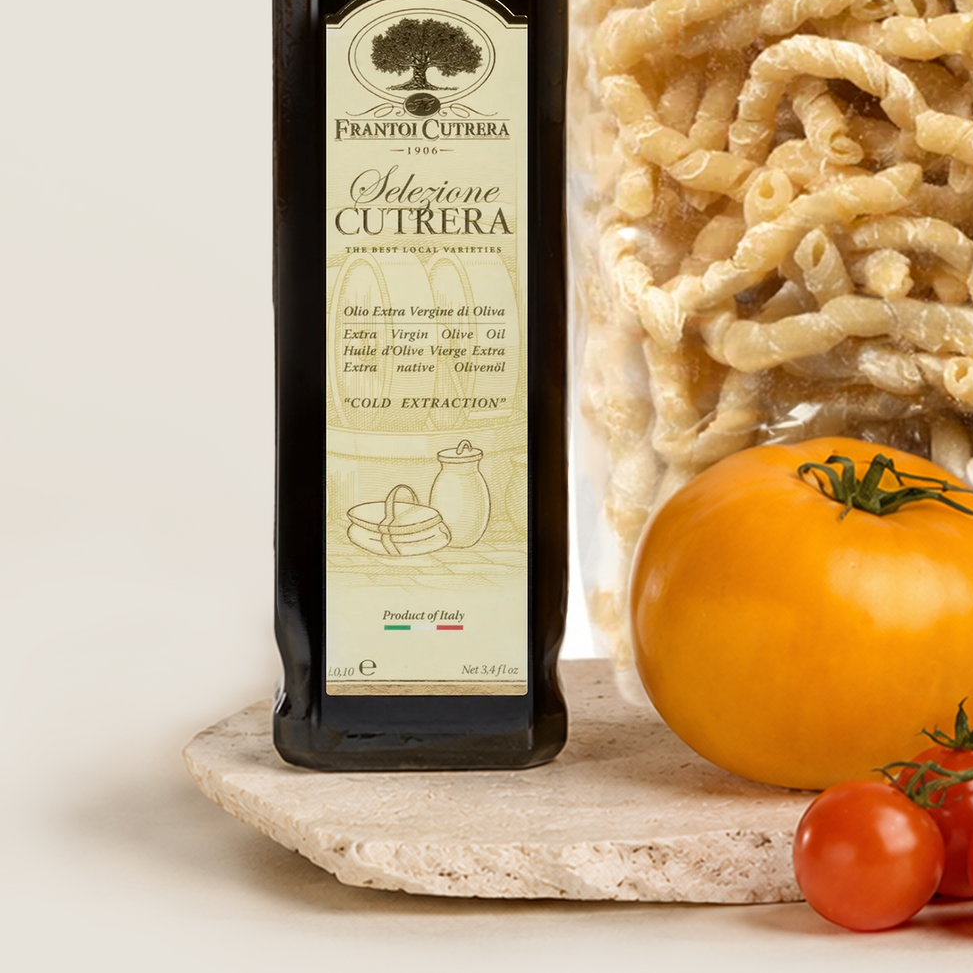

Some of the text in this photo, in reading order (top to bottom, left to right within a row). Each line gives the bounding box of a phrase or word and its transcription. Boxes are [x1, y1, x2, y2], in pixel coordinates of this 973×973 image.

[334, 118, 511, 141] FRANTOI CUTRERA
[406, 146, 438, 155] 1906
[349, 164, 500, 220] Selezione
[334, 206, 514, 236] CUTRERA
[345, 246, 502, 254] THE BEST LOCAL VARIETIES
[343, 305, 505, 319] Olio Extra Vergine di Oliva
[343, 328, 506, 342] Extra Virgin Olive Oil
[343, 345, 505, 359] Huile d’Olive Vierge Extra
[343, 362, 506, 373] Extra native Olivenöl
[382, 609, 465, 623] Product of Italy
[461, 664, 479, 675] Net
[480, 664, 496, 676] 3,4
[507, 667, 519, 675] oz
